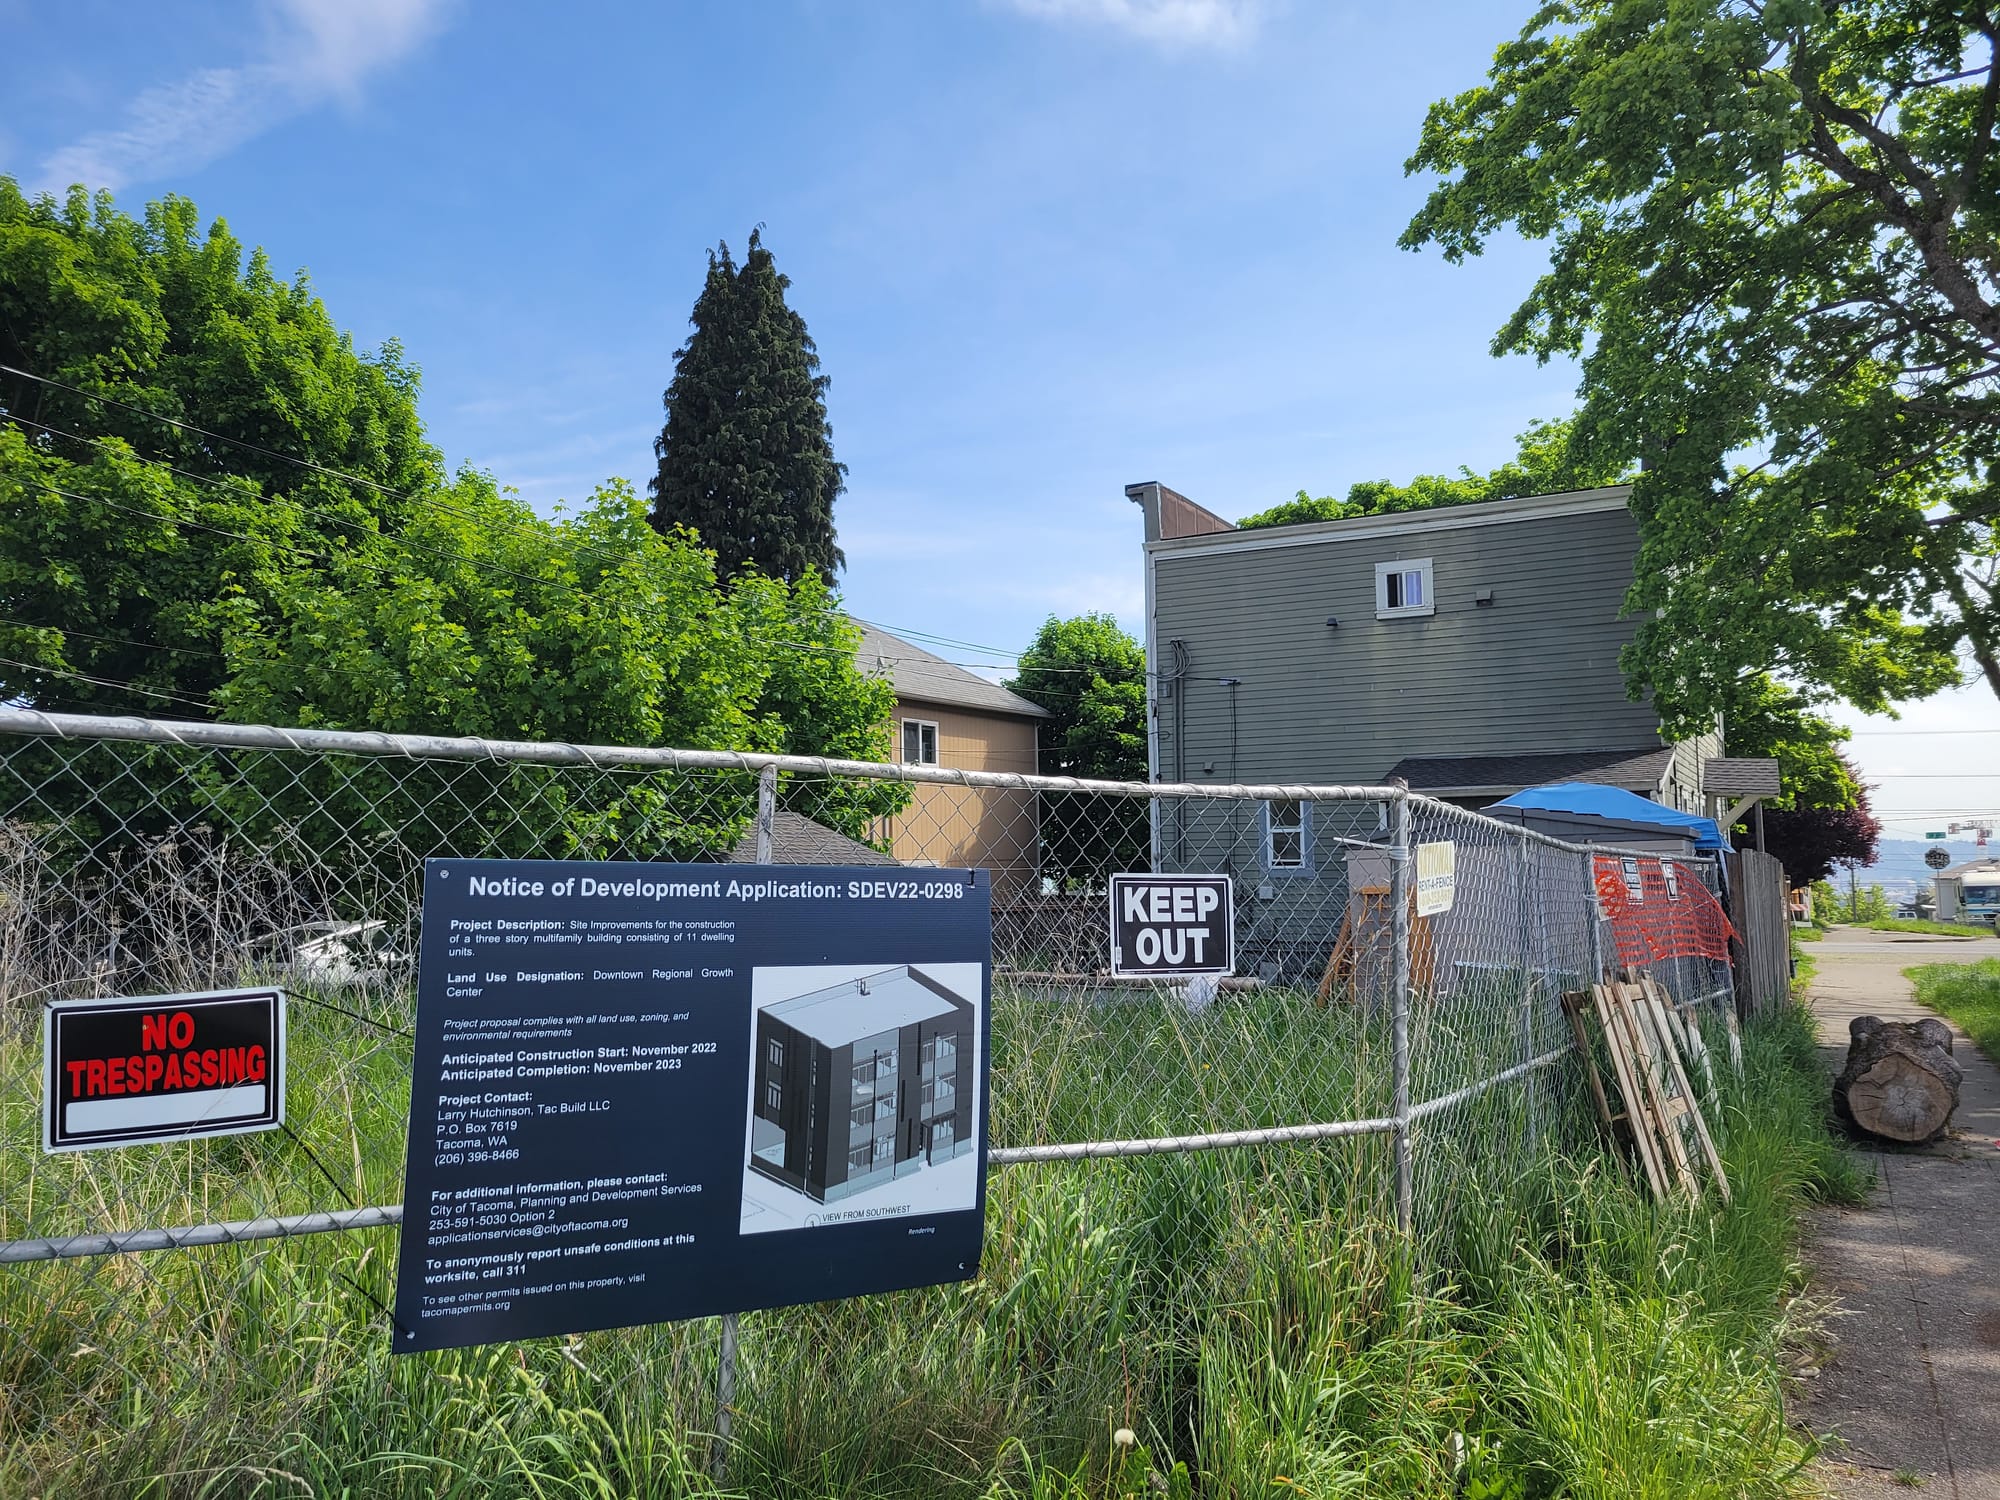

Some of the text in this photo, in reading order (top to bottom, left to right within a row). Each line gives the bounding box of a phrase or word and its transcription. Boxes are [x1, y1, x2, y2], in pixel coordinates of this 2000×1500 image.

[469, 876, 963, 901] Notice of Development Application: SDEV22-0298
[1124, 887, 1219, 922] KEEP
[450, 919, 734, 932] Project Description: Site Improvements for the construction
[449, 934, 459, 943] of
[475, 934, 500, 943] three
[505, 934, 529, 944] story
[533, 933, 582, 944] multifamily
[587, 933, 622, 944] building
[626, 932, 669, 943] consisting
[673, 932, 682, 941] of
[686, 932, 696, 941] 11
[700, 932, 734, 942] dwelling
[1136, 928, 1210, 965] OUT
[448, 946, 475, 956] units.
[447, 968, 733, 983] Land Use Designation: Downtown Regional Growth
[446, 986, 483, 997] Center
[443, 1019, 478, 1030] Project
[479, 1017, 521, 1029] proposal
[522, 1016, 563, 1027] complies
[565, 1015, 583, 1024] with
[585, 1014, 597, 1023] all
[598, 1014, 618, 1023] land
[640, 1012, 670, 1022] zoning,
[672, 1011, 689, 1020] and
[142, 1011, 195, 1051] NO
[442, 1028, 572, 1041] environmental requirements
[441, 1042, 716, 1066] Anticipated Construction Start: November 2022
[66, 1045, 266, 1097] TRESPASSING
[440, 1058, 681, 1081] Anticipated Completion: November 2023
[438, 1091, 532, 1107] Project Contact:
[437, 1100, 610, 1121] Larry Hutchinson, Tac Build LLC
[436, 1120, 517, 1135] P.O. Box 7619
[435, 1135, 507, 1150] Tacoma, WA
[434, 1148, 519, 1167] (206) 396-8466
[431, 1172, 667, 1201] For additional information, please contact:
[430, 1183, 702, 1216] City of Tacoma, Planning and Development Services
[428, 1209, 555, 1230] 253-591-5030 Option 2
[822, 1205, 910, 1221] VIEW FROM SOUTHWEST
[427, 1218, 628, 1246] applicationservices@cityoftacoma.org
[908, 1227, 936, 1236] Rendering
[426, 1233, 694, 1269] To anonymously report unsafe conditions at this
[424, 1264, 525, 1284] worksite, call 311
[422, 1273, 645, 1305] To see other permits issued on this property, visit
[421, 1301, 510, 1318] tacomapermits.org
